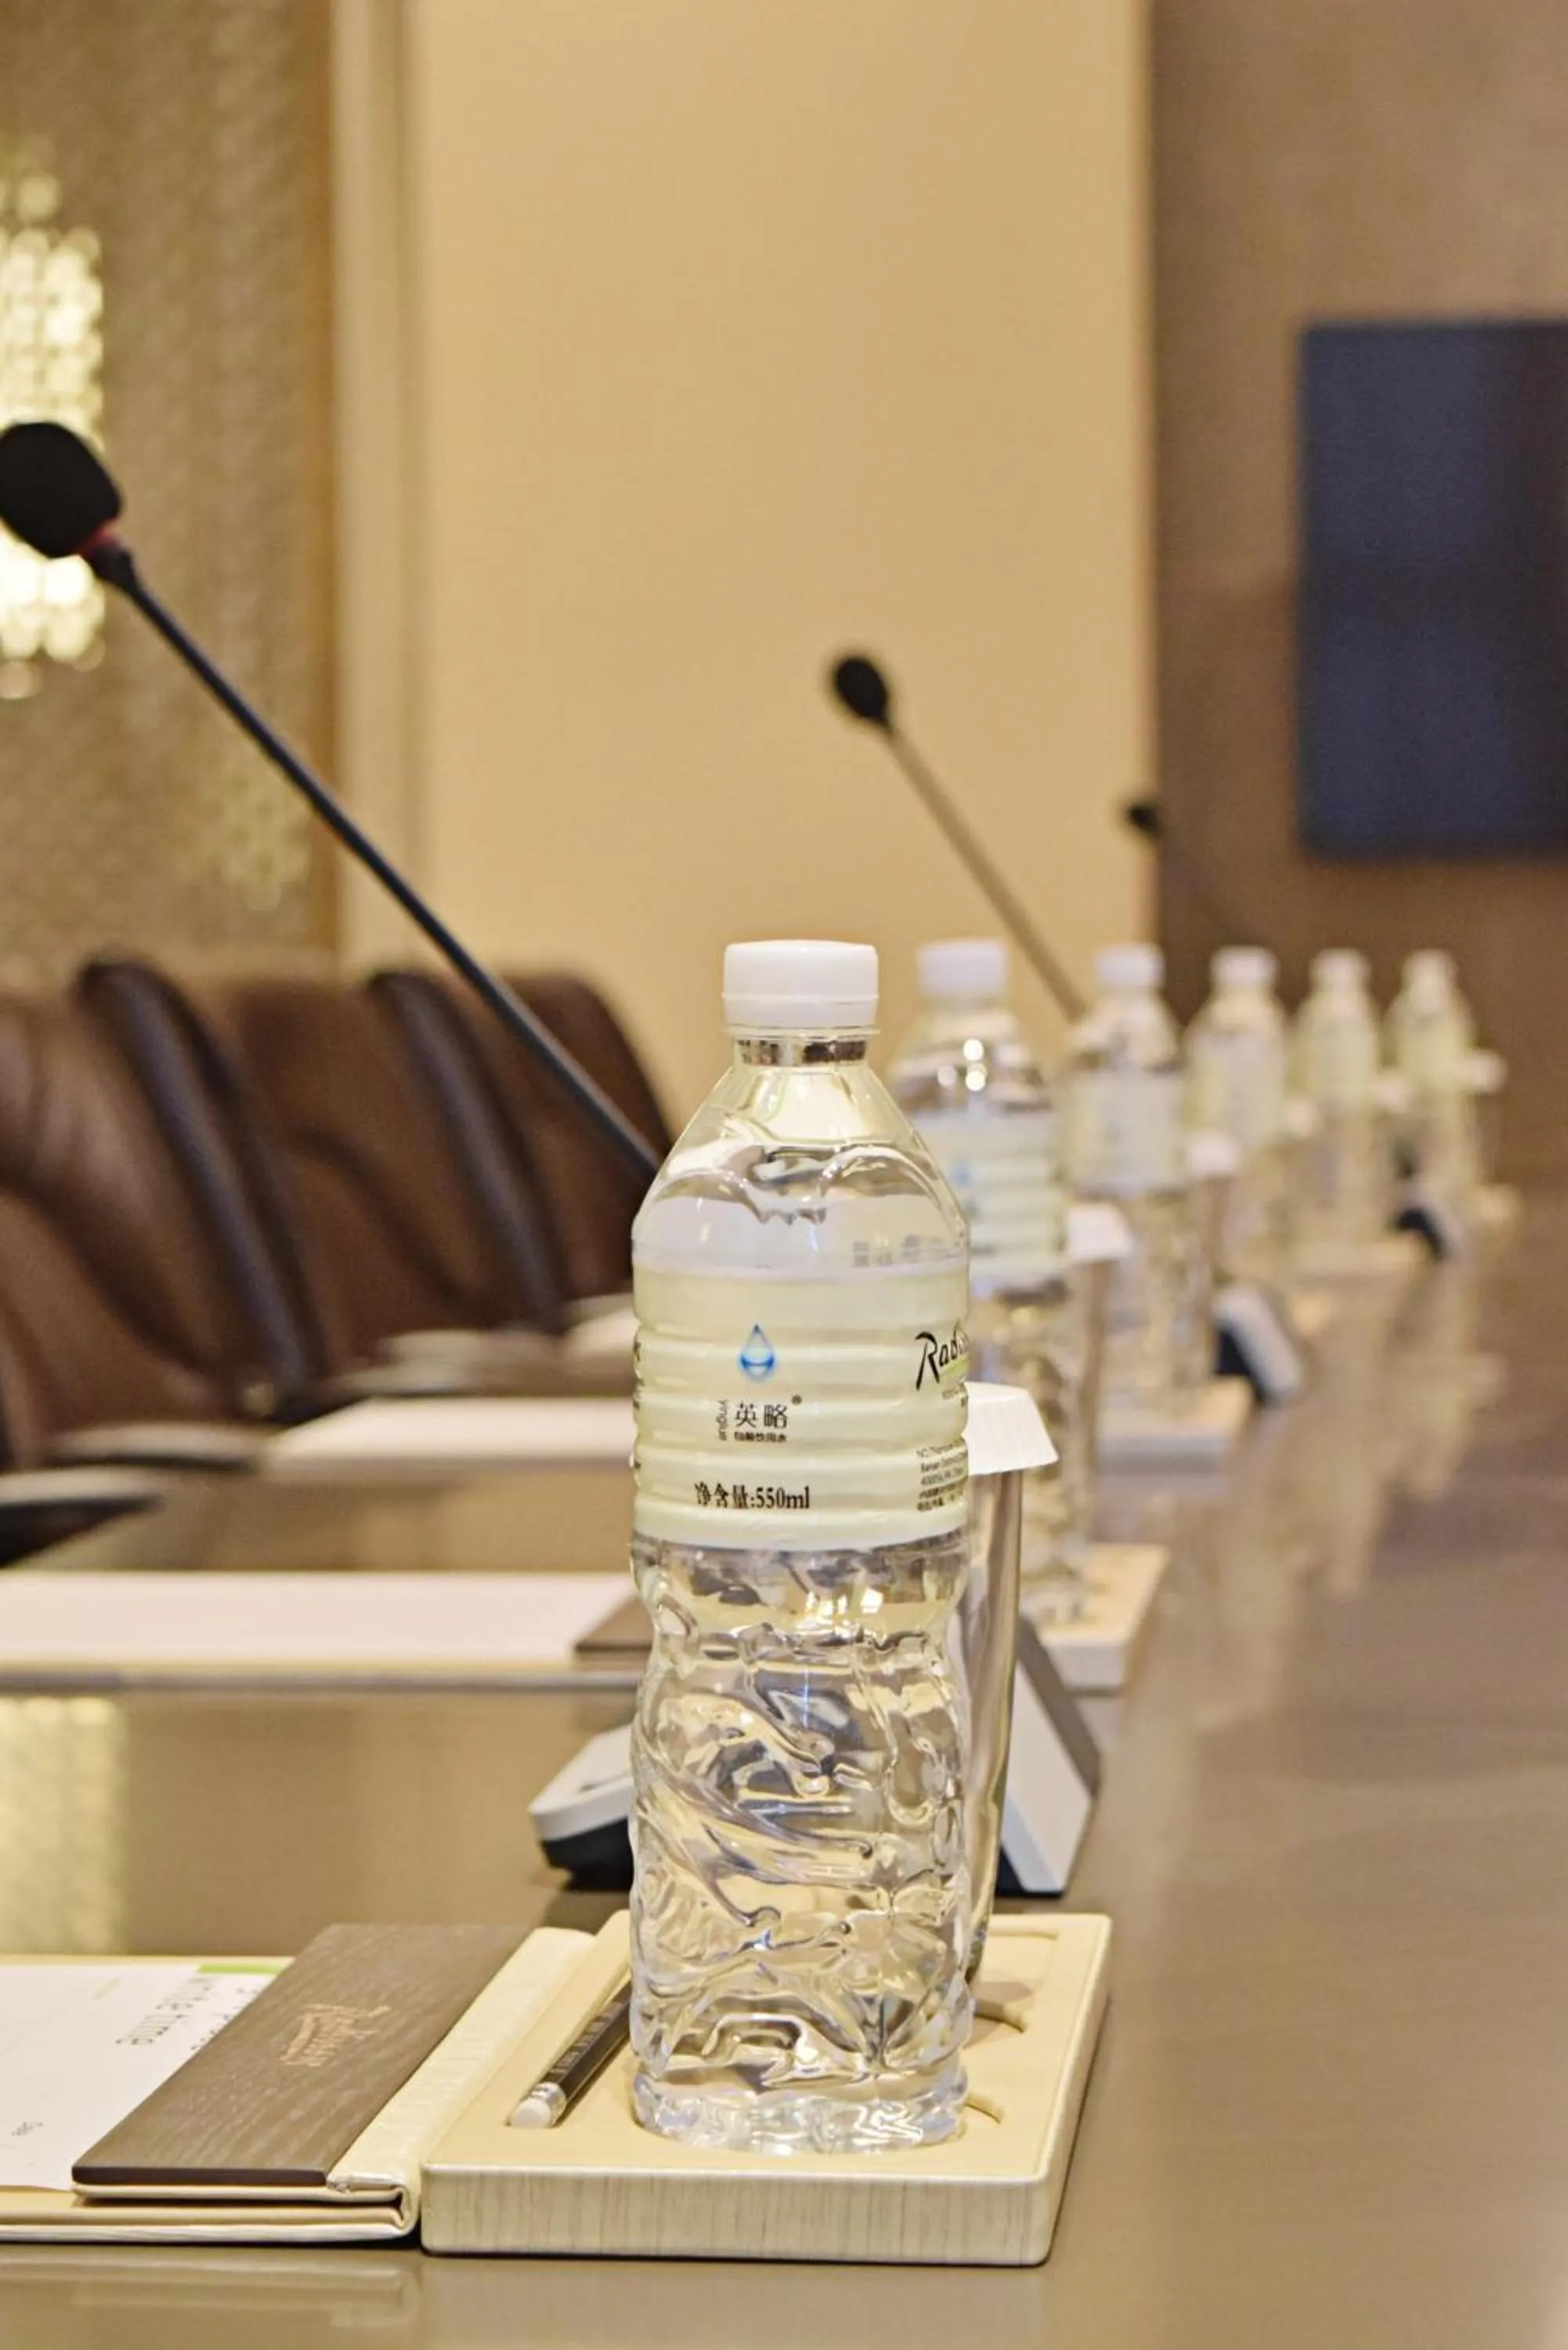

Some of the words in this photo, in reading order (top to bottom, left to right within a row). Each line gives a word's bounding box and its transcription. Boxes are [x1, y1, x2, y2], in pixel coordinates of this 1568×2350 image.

[735, 1403, 788, 1429] 英略
[694, 1482, 811, 1509] 净含量:550ml
